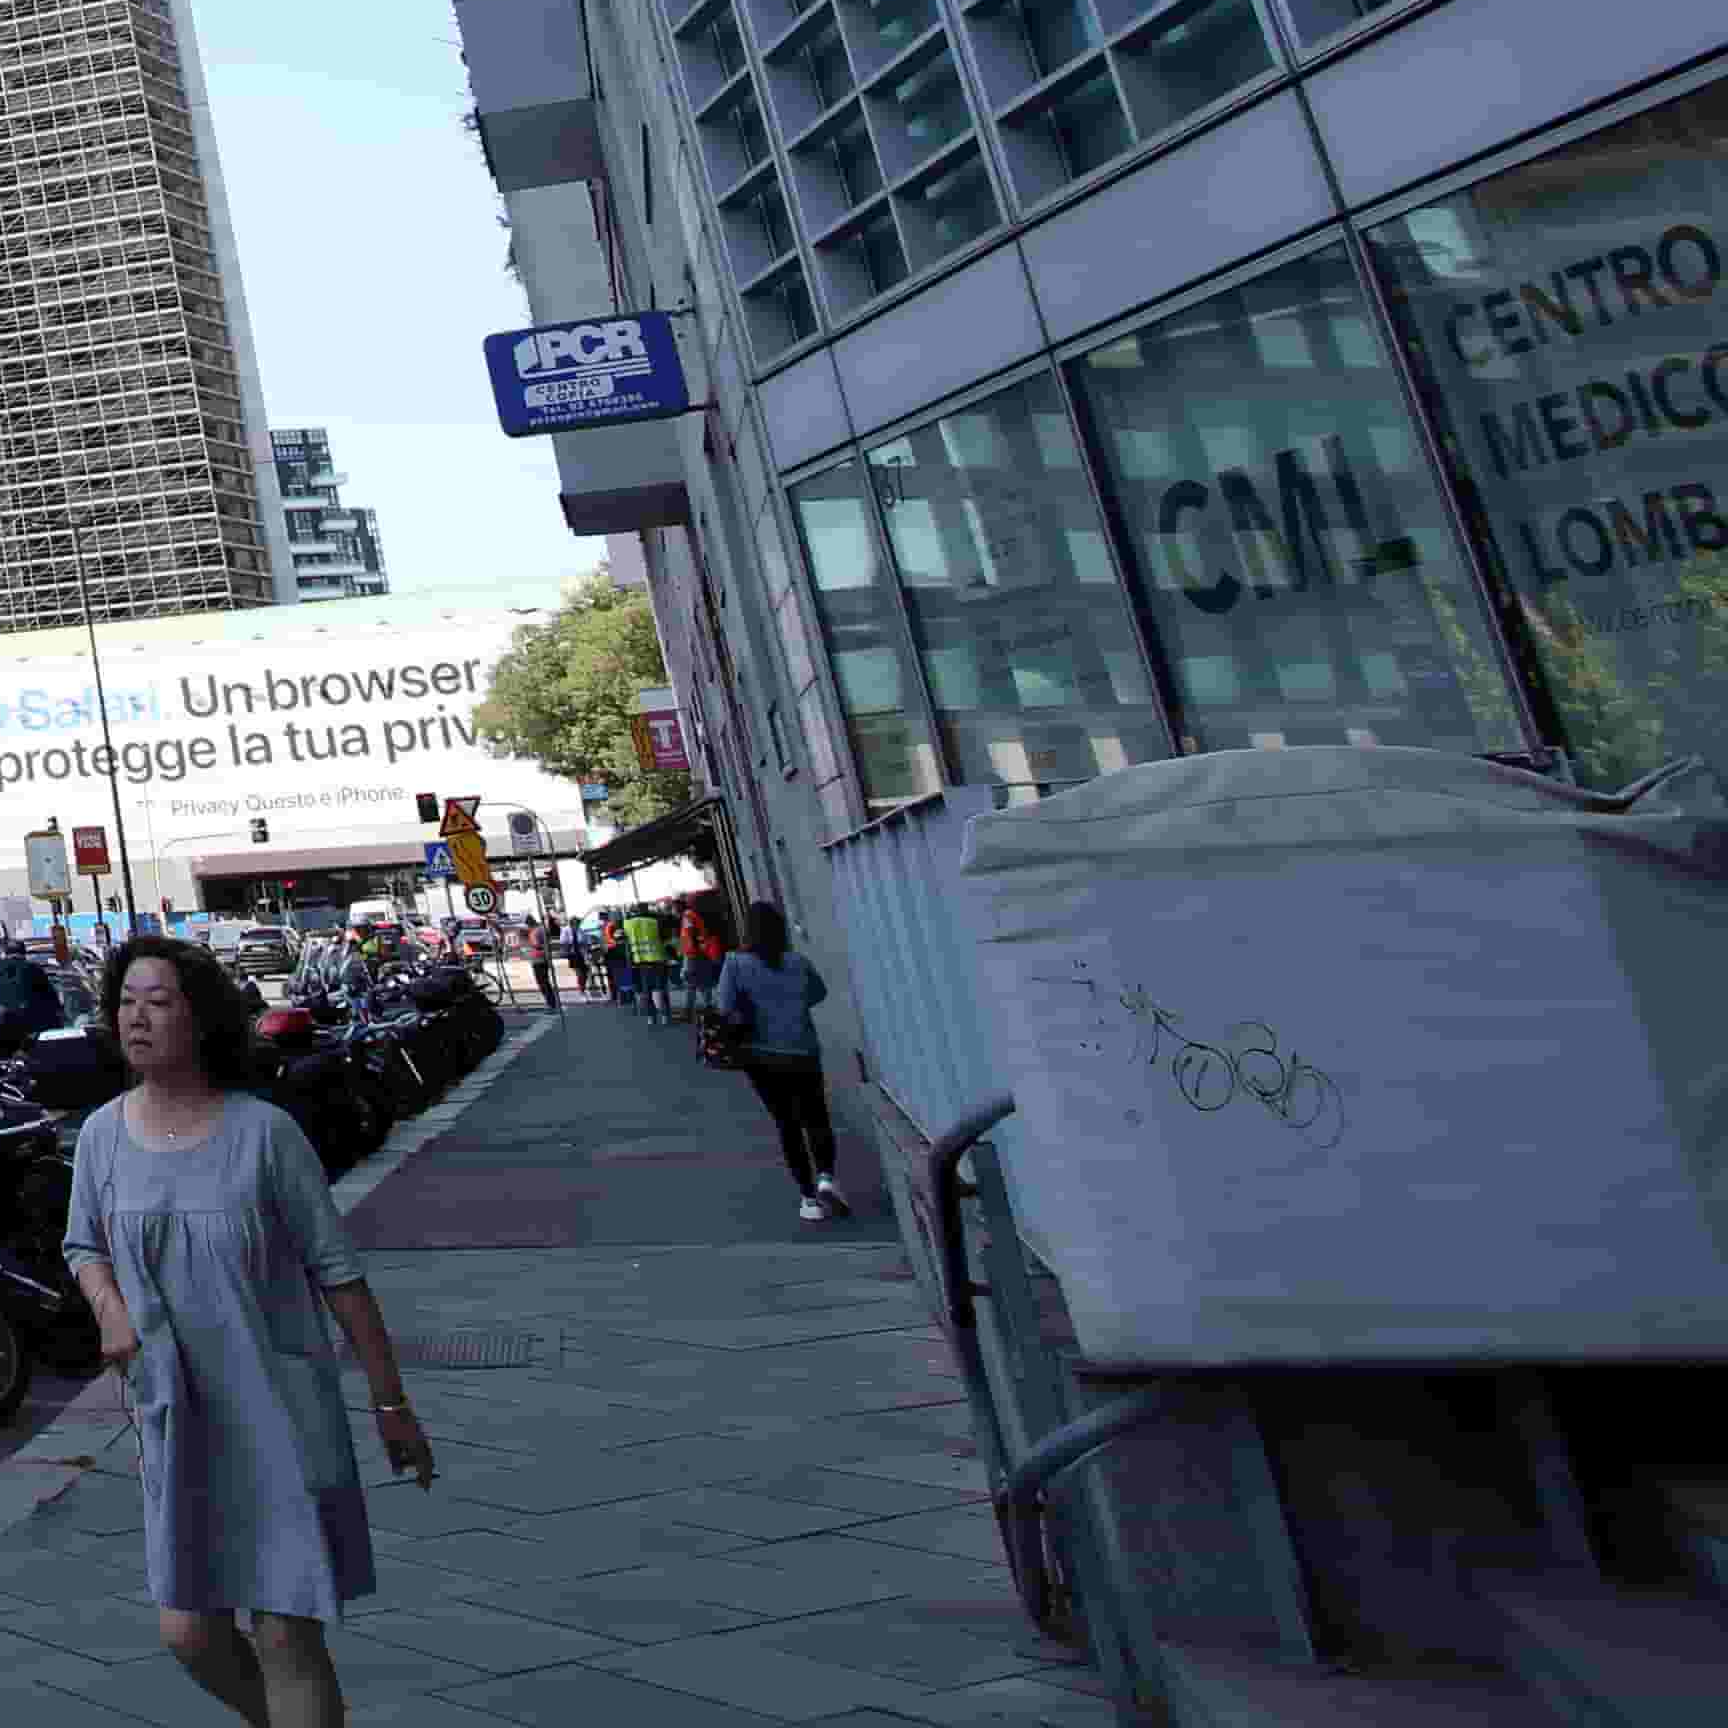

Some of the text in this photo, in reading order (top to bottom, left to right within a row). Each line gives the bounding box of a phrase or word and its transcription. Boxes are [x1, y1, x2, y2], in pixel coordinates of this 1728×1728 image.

[1444, 223, 1722, 369] CENTRO
[535, 377, 601, 395] CENTRO
[545, 389, 596, 402] COPIA
[1157, 432, 1426, 615] CML
[178, 673, 254, 718] Un
[263, 657, 481, 712] browser
[227, 722, 273, 767] la
[282, 721, 371, 762] tua
[244, 792, 314, 813] Questo
[471, 889, 490, 906] 30
